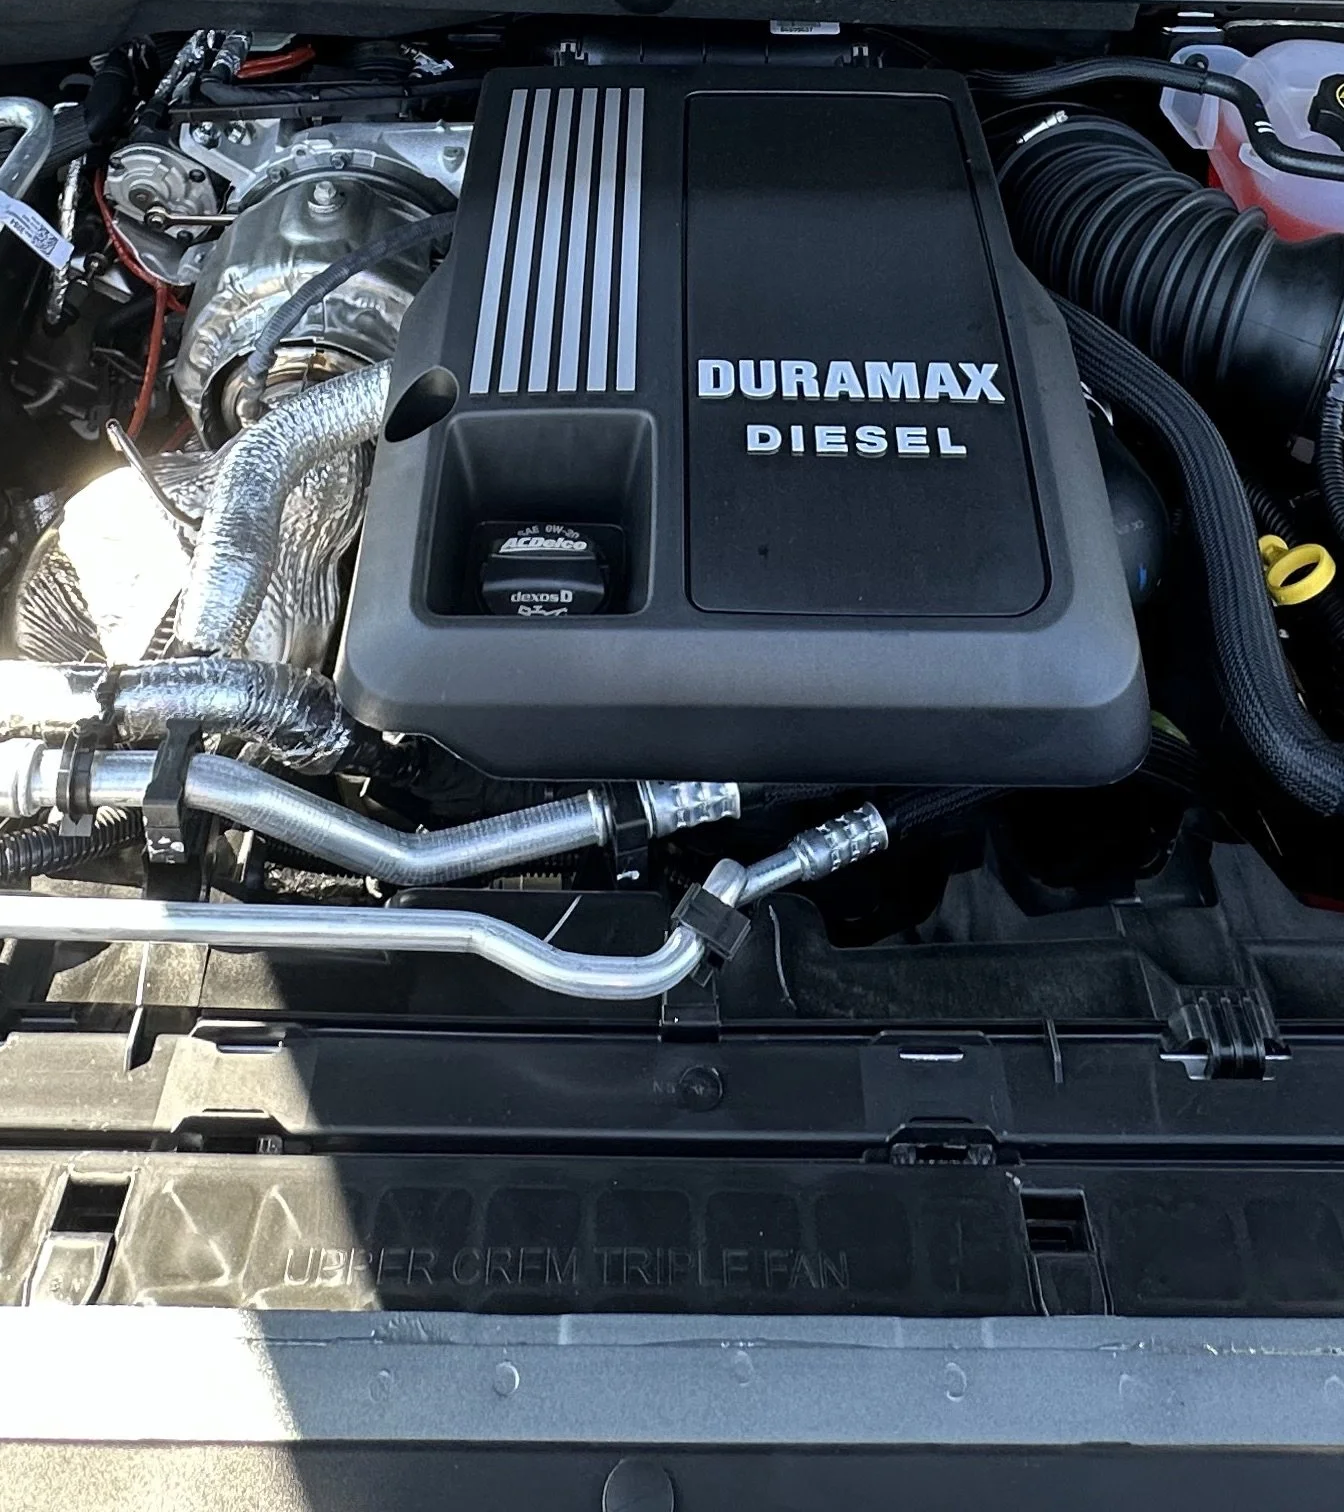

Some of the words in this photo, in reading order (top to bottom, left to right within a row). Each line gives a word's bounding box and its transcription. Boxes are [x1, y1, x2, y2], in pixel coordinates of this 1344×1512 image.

[697, 359, 1006, 403] DURAMAX
[746, 424, 967, 456] DIESEL
[498, 537, 588, 554] ACDelco
[517, 525, 540, 537] SAE
[283, 1247, 434, 1286] UPPER
[592, 1246, 749, 1287] TRIPLE
[764, 1248, 850, 1289] FAN
